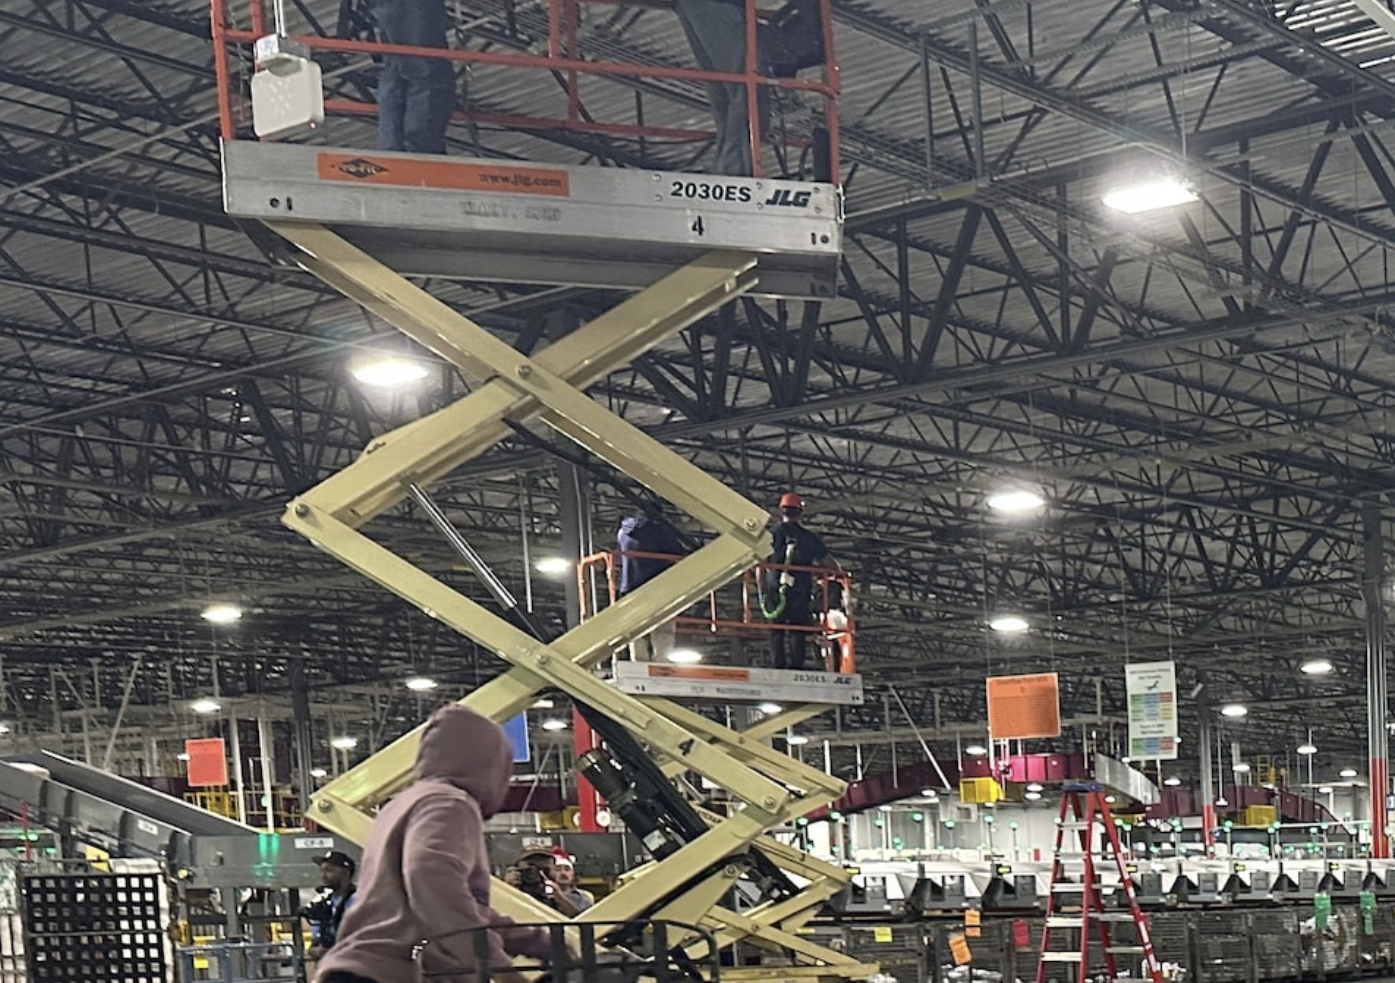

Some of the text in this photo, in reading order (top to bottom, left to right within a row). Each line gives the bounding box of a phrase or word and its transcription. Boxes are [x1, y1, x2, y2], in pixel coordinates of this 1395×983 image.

[671, 181, 752, 202] 2030ES
[765, 189, 812, 207] JLG
[691, 215, 705, 236] 4
